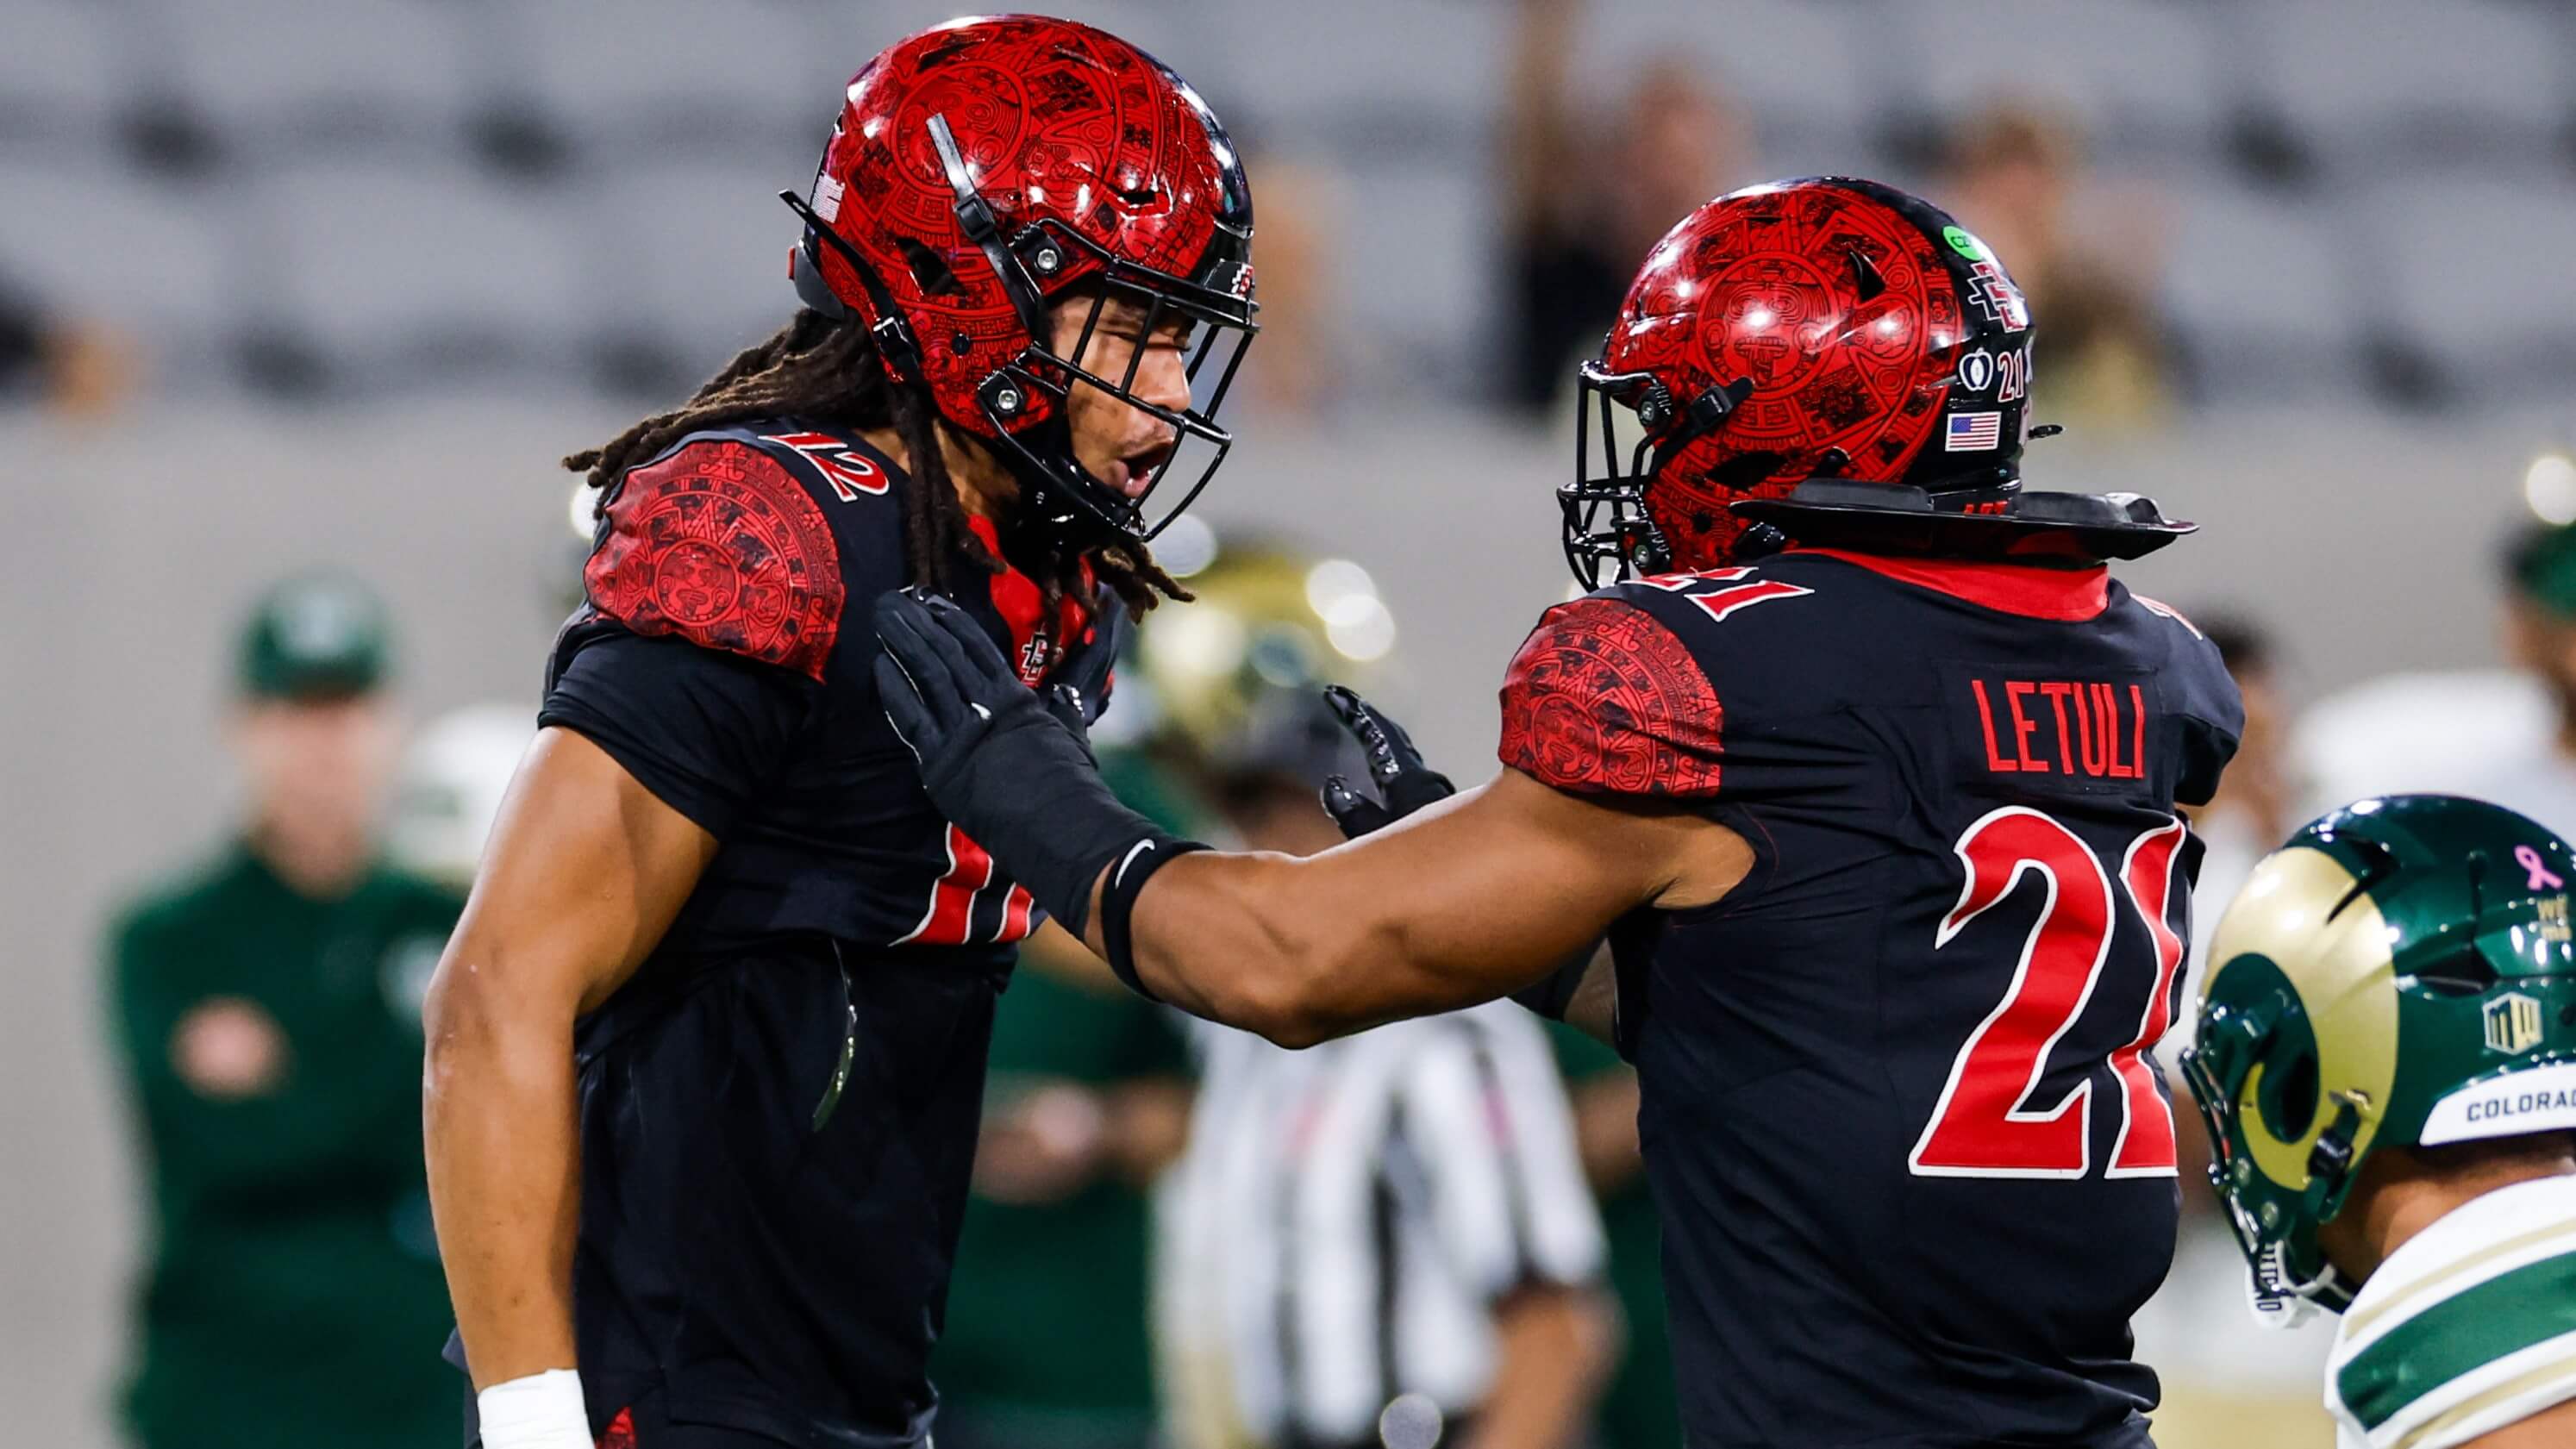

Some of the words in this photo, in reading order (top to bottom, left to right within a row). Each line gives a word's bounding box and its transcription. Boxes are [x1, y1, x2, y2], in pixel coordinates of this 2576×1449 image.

[1997, 347, 2025, 403] 21
[757, 432, 890, 503] 12
[1972, 679, 2146, 779] LETULI
[1908, 805, 2185, 1179] 21
